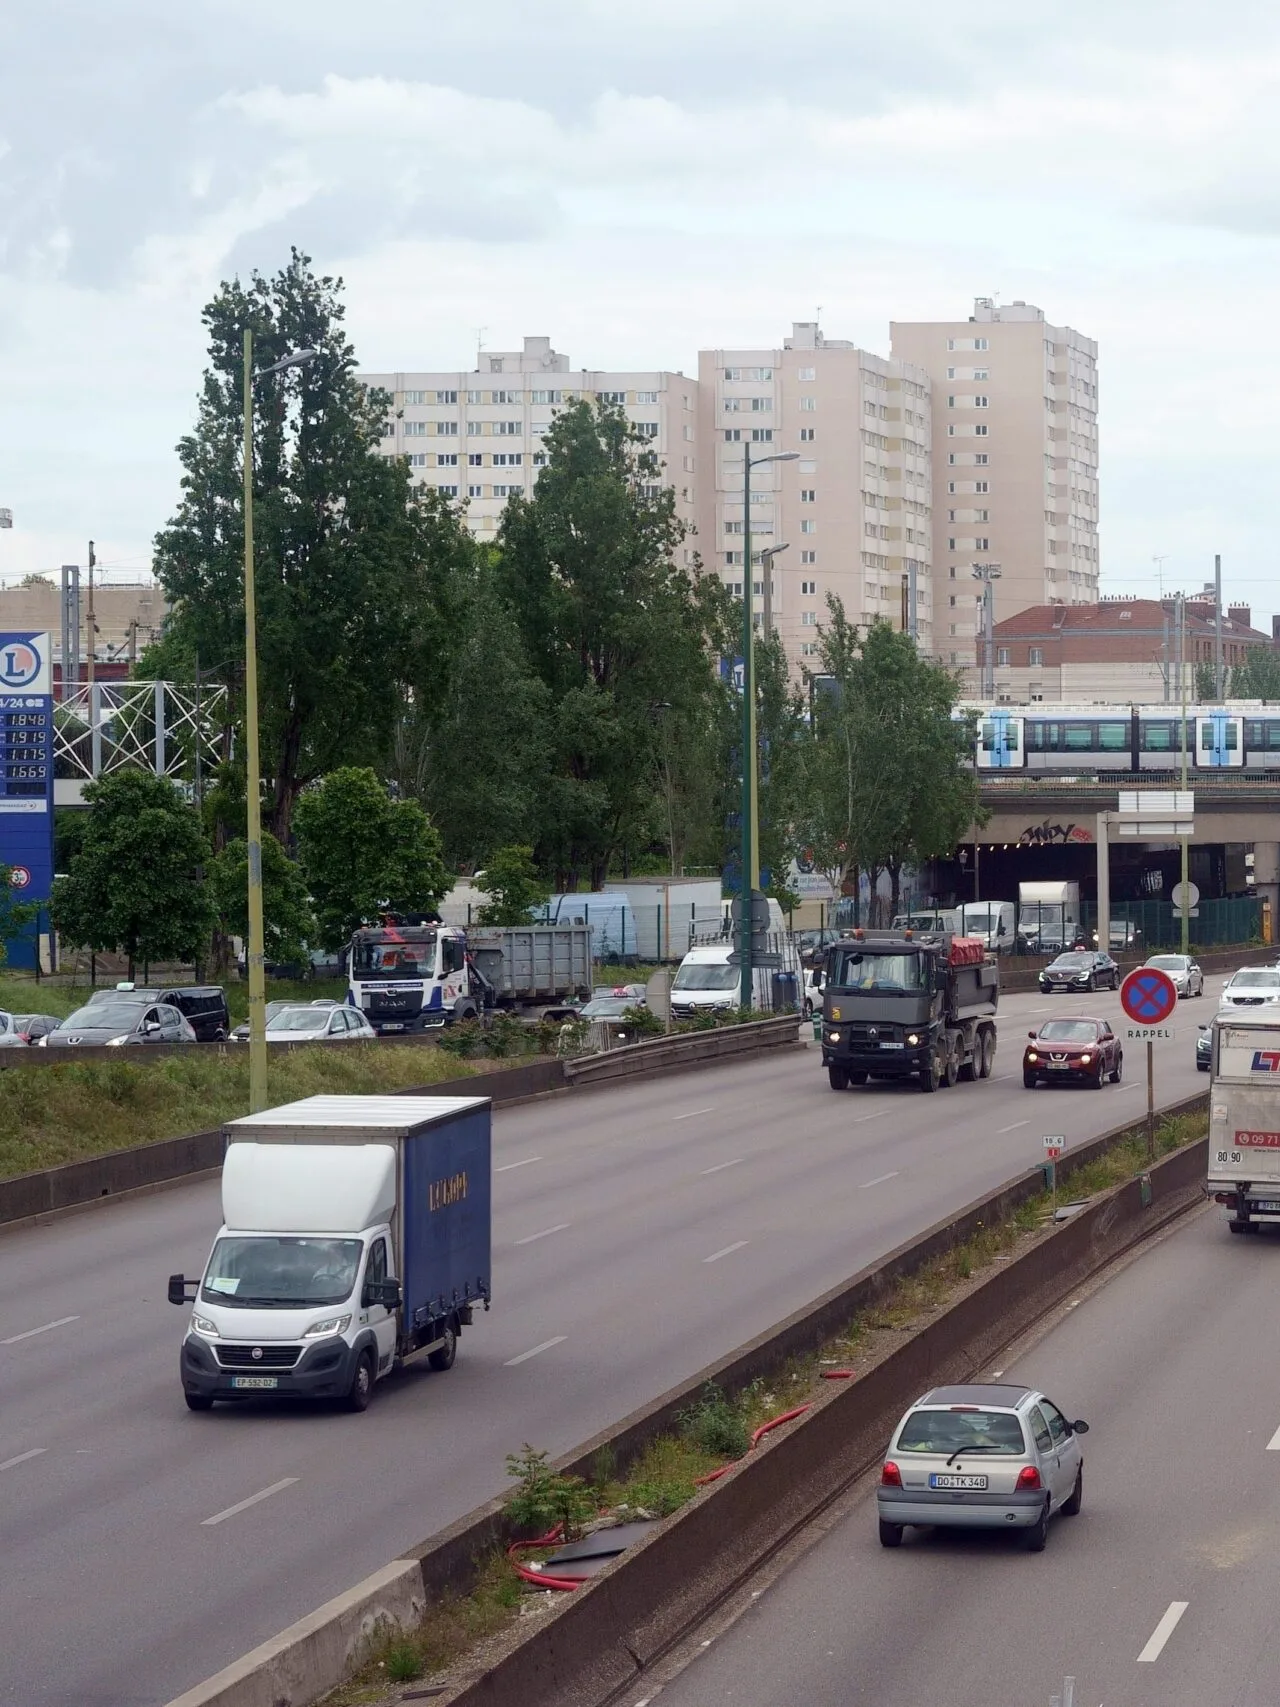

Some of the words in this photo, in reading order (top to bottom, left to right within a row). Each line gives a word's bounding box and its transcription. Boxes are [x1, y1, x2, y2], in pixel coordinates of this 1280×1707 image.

[12, 714, 46, 726] 1.848
[12, 731, 46, 743] 1.919
[1127, 1030, 1170, 1038] RAPPEL
[1252, 1134, 1264, 1144] 09
[1267, 1135, 1278, 1144] 71
[1218, 1151, 1228, 1162] 80
[1231, 1152, 1241, 1163] 90
